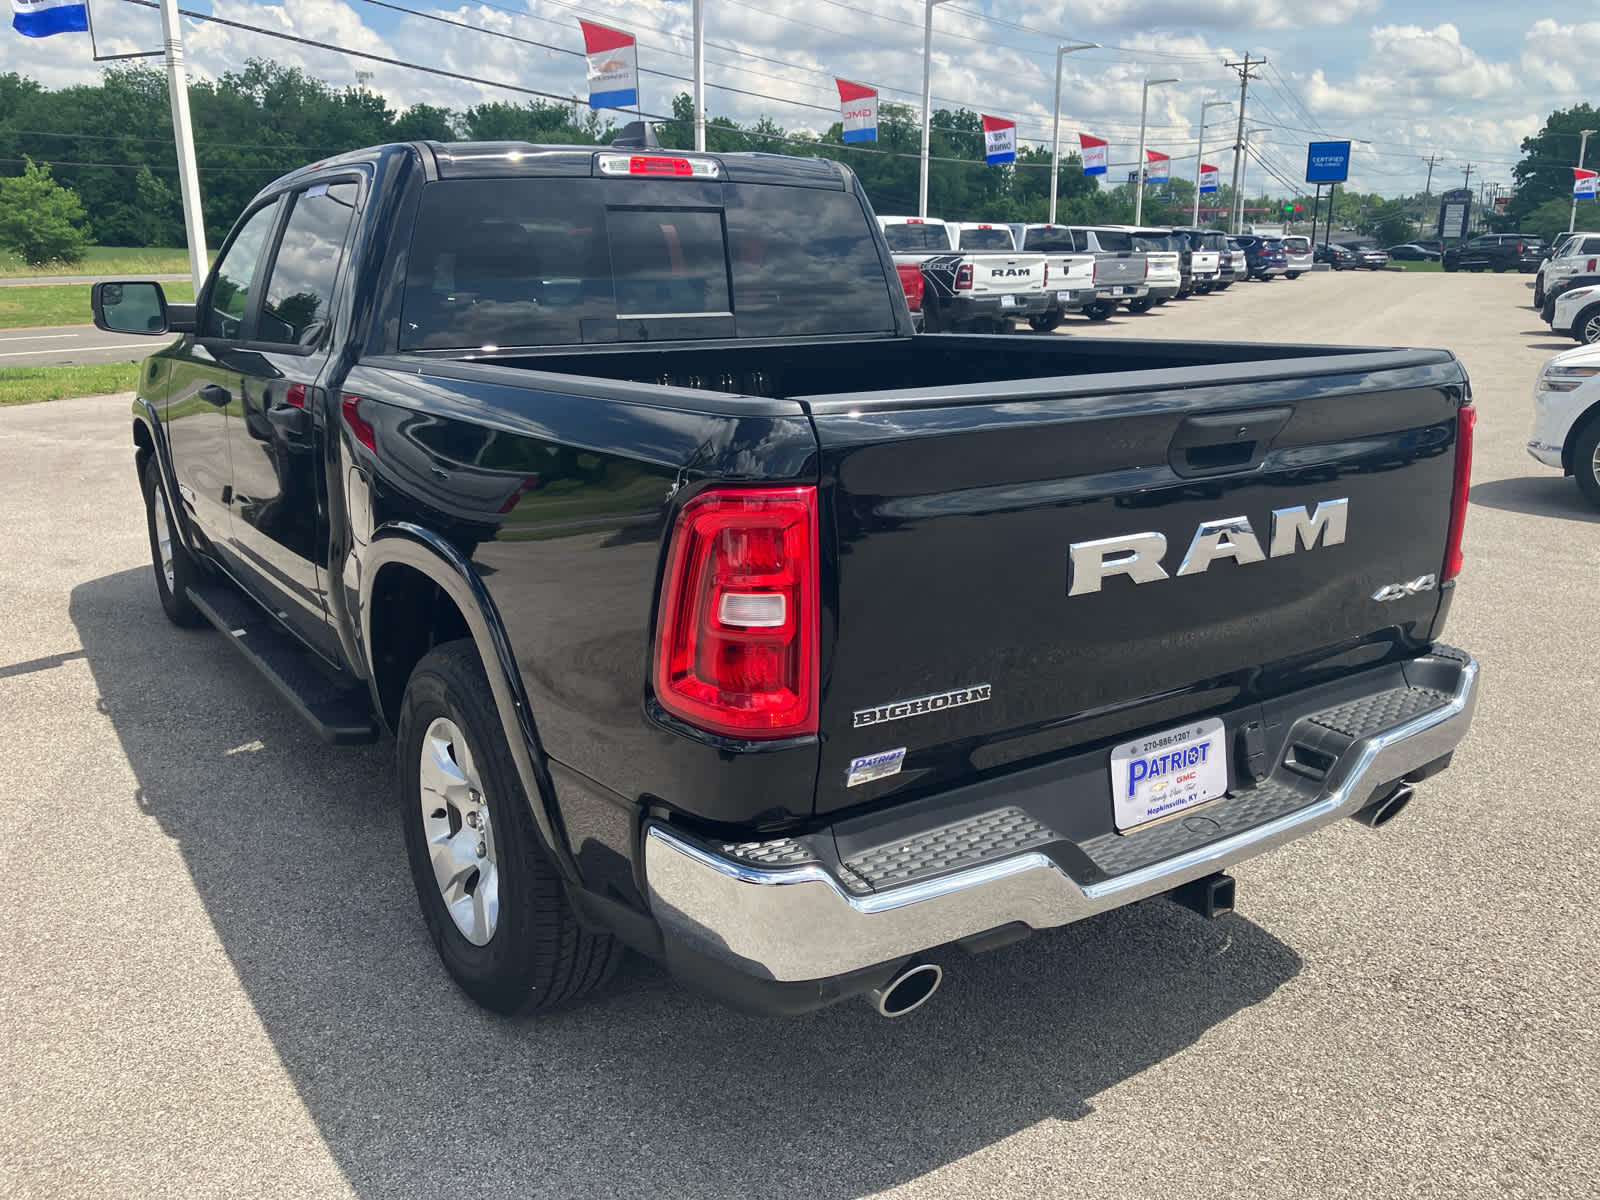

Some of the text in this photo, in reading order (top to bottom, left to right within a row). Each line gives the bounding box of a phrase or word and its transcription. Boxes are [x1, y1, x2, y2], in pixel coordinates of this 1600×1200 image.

[991, 268, 1030, 277] RAM
[1067, 497, 1349, 597] RAM
[852, 684, 992, 728] BIGHORN
[852, 751, 904, 774] PATRIOT
[1127, 742, 1210, 798] PATRIOT
[1175, 771, 1197, 784] GMC
[1188, 792, 1198, 803] KY
